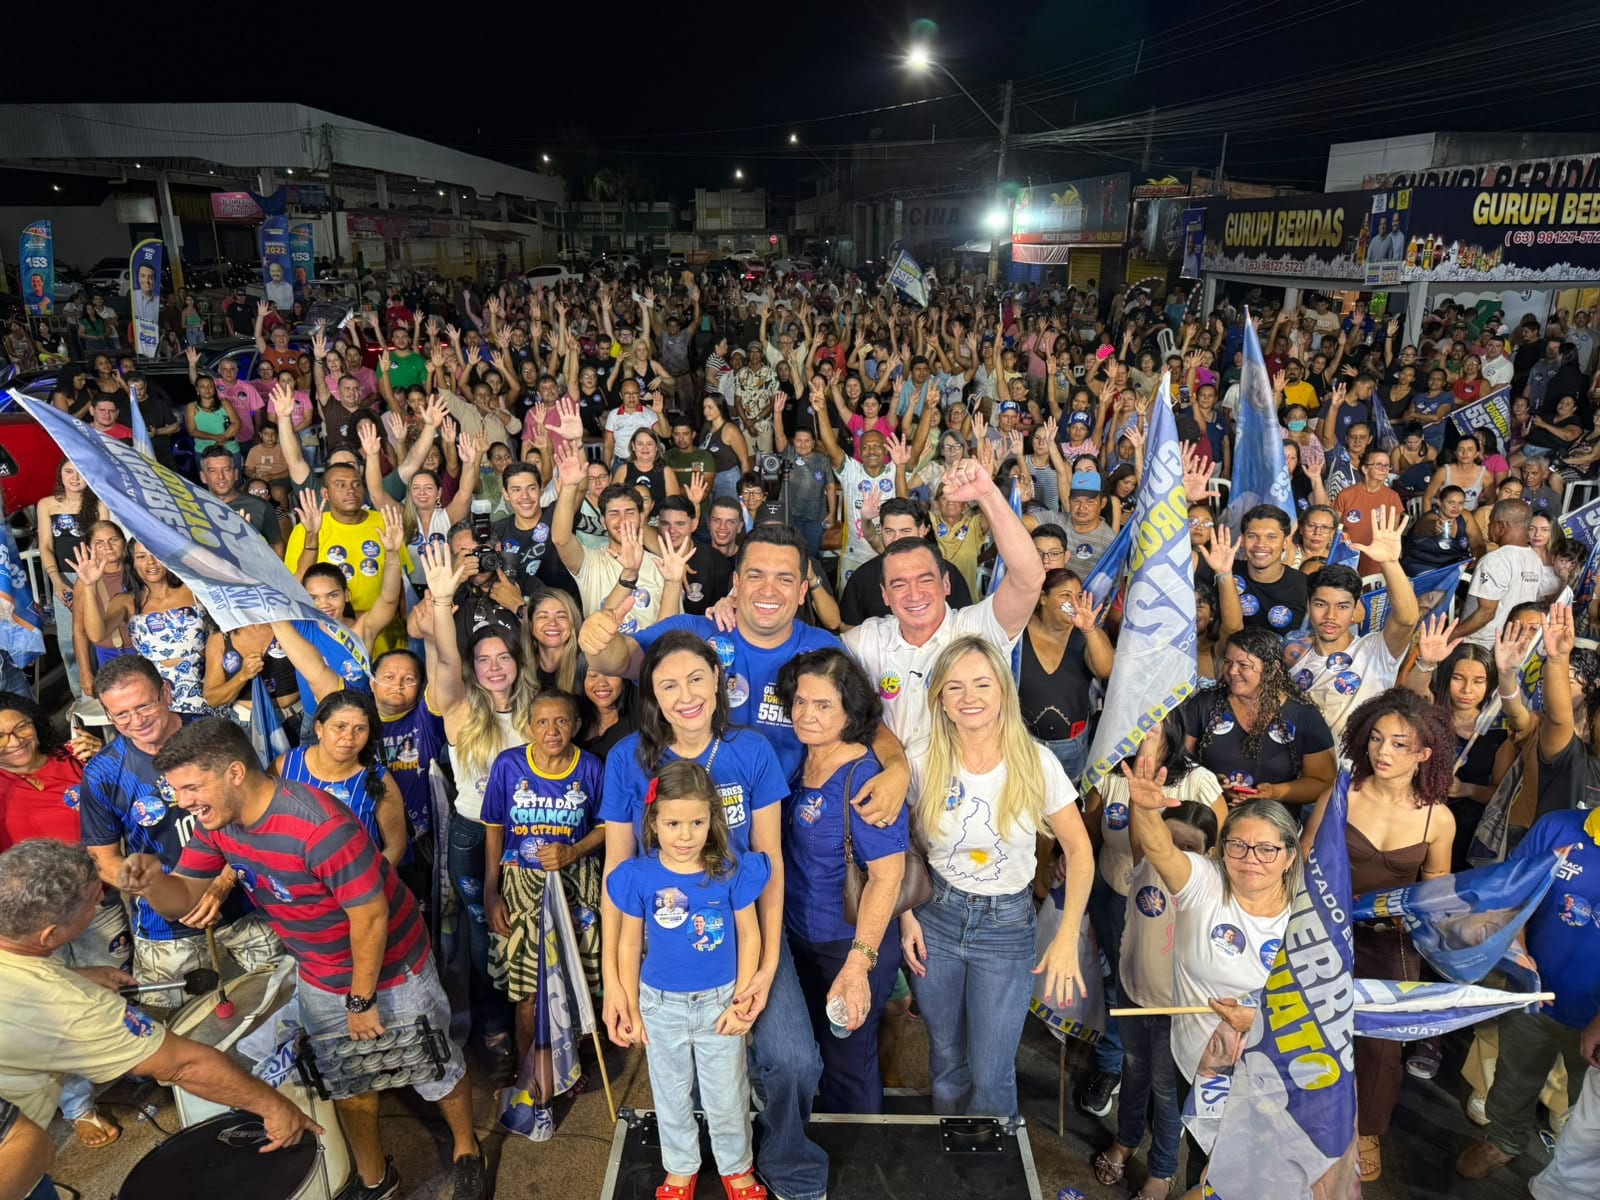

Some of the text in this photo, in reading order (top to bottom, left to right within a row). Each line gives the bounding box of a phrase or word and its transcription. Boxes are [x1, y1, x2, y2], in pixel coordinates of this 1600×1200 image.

[1473, 192, 1559, 225] GURUPI
[1225, 211, 1275, 248] GURUPI
[1275, 207, 1345, 247] BEBIDAS
[265, 246, 286, 255] 2022
[26, 256, 48, 268] 153
[291, 252, 310, 262] 153
[1261, 260, 1303, 272] 98127-5723
[1381, 273, 1399, 283] 2022
[516, 796, 578, 811] FESTA DAS
[510, 805, 585, 827] CRIANÇAS
[515, 825, 530, 837] DO
